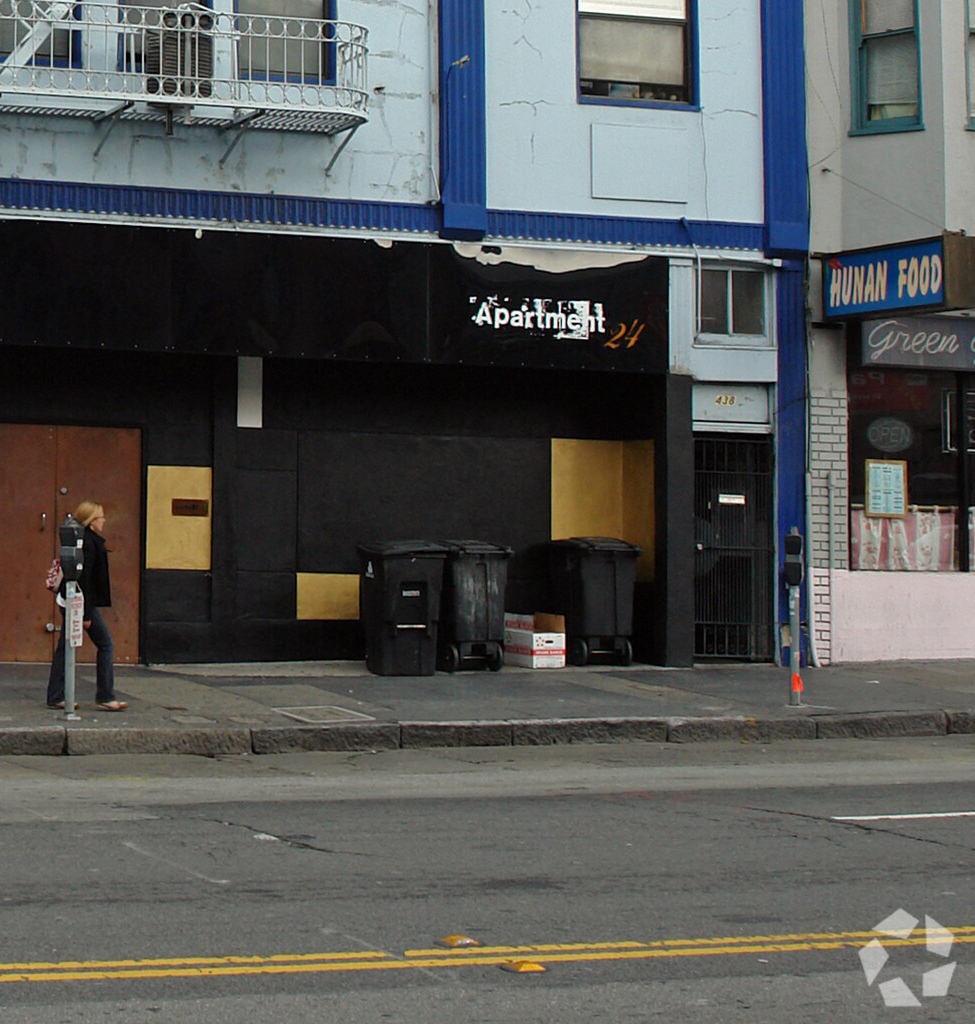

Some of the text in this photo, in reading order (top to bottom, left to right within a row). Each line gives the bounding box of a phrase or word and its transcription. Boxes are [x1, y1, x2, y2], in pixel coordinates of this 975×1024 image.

[830, 254, 943, 308] HUNAN FOOD
[474, 300, 645, 349] Apartment 24
[868, 320, 959, 360] Green
[714, 395, 736, 407] 438
[868, 426, 911, 443] OPEN
